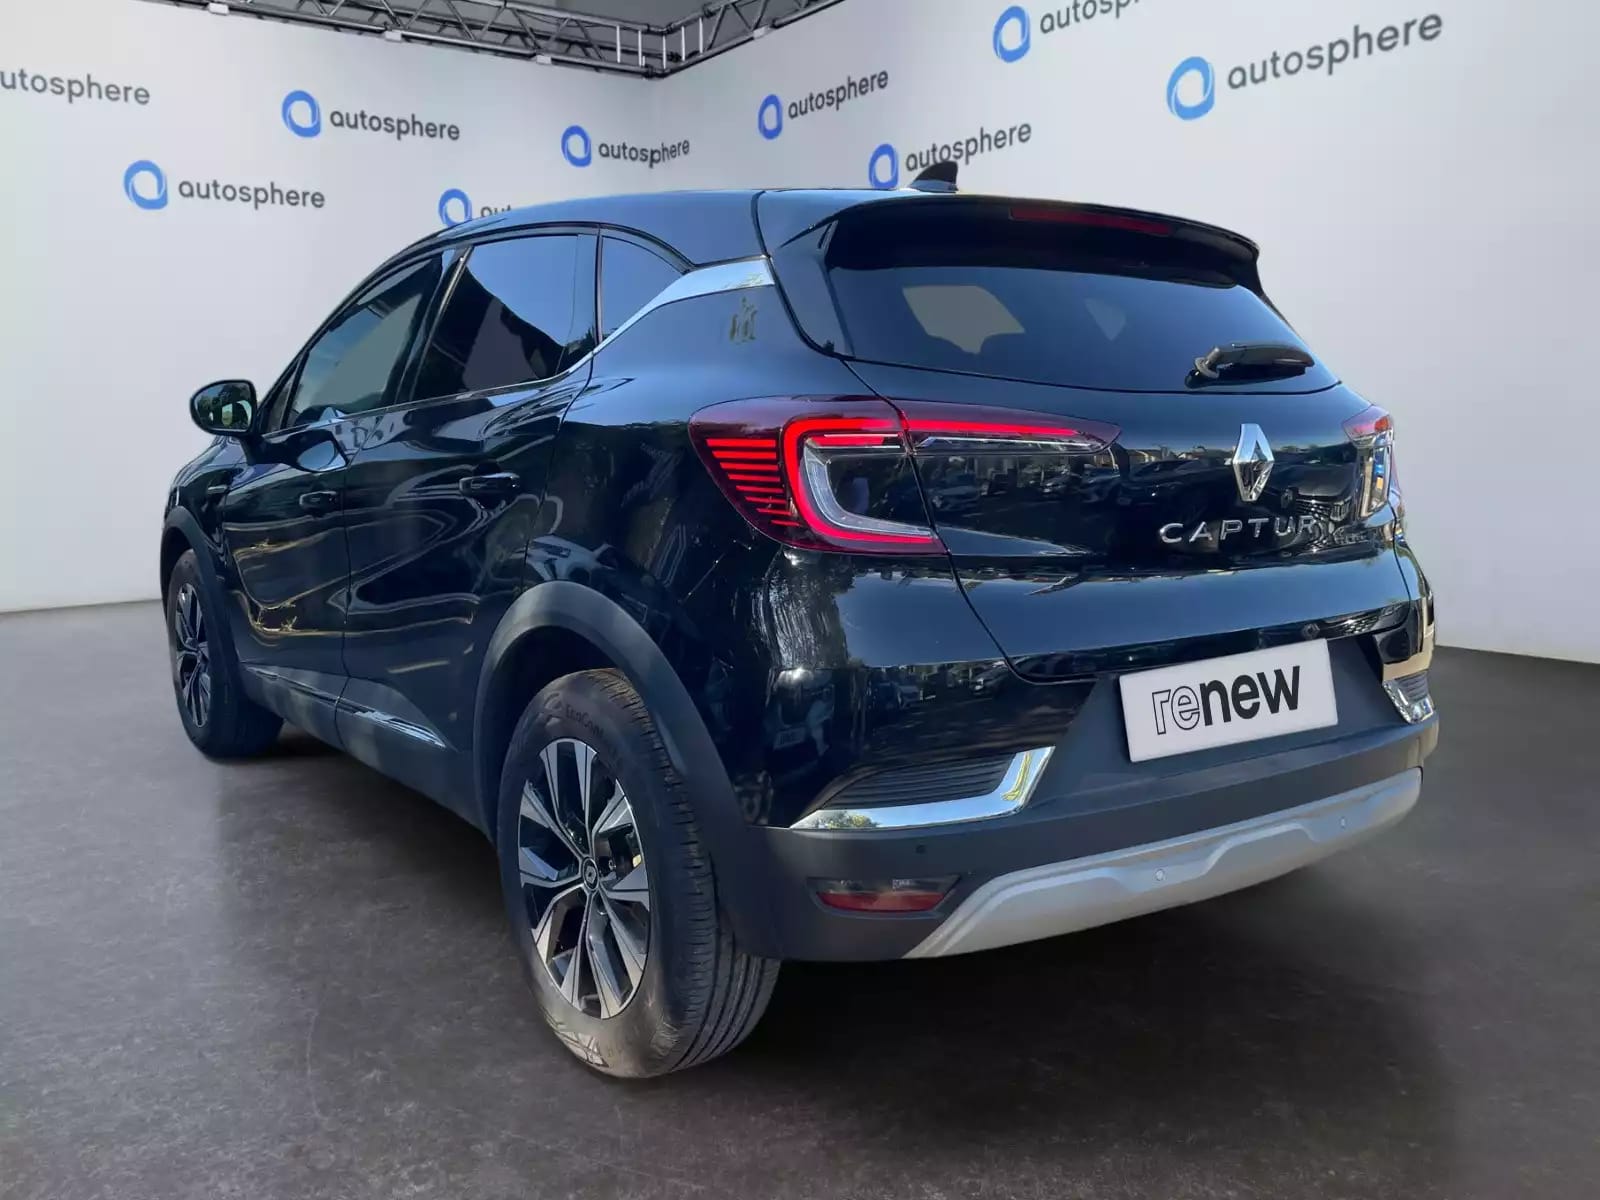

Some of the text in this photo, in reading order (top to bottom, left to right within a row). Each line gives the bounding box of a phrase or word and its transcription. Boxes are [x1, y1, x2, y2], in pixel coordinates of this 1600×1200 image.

[1040, 0, 1140, 34] autosp
[1228, 13, 1444, 89] autosphere
[787, 70, 889, 120] autosphere
[329, 109, 461, 141] autosphere
[598, 139, 691, 169] autosphere
[905, 123, 1032, 172] autosphere
[178, 179, 326, 210] autosphere
[1159, 515, 1316, 544] CAPTUR
[1151, 665, 1301, 736] renew
